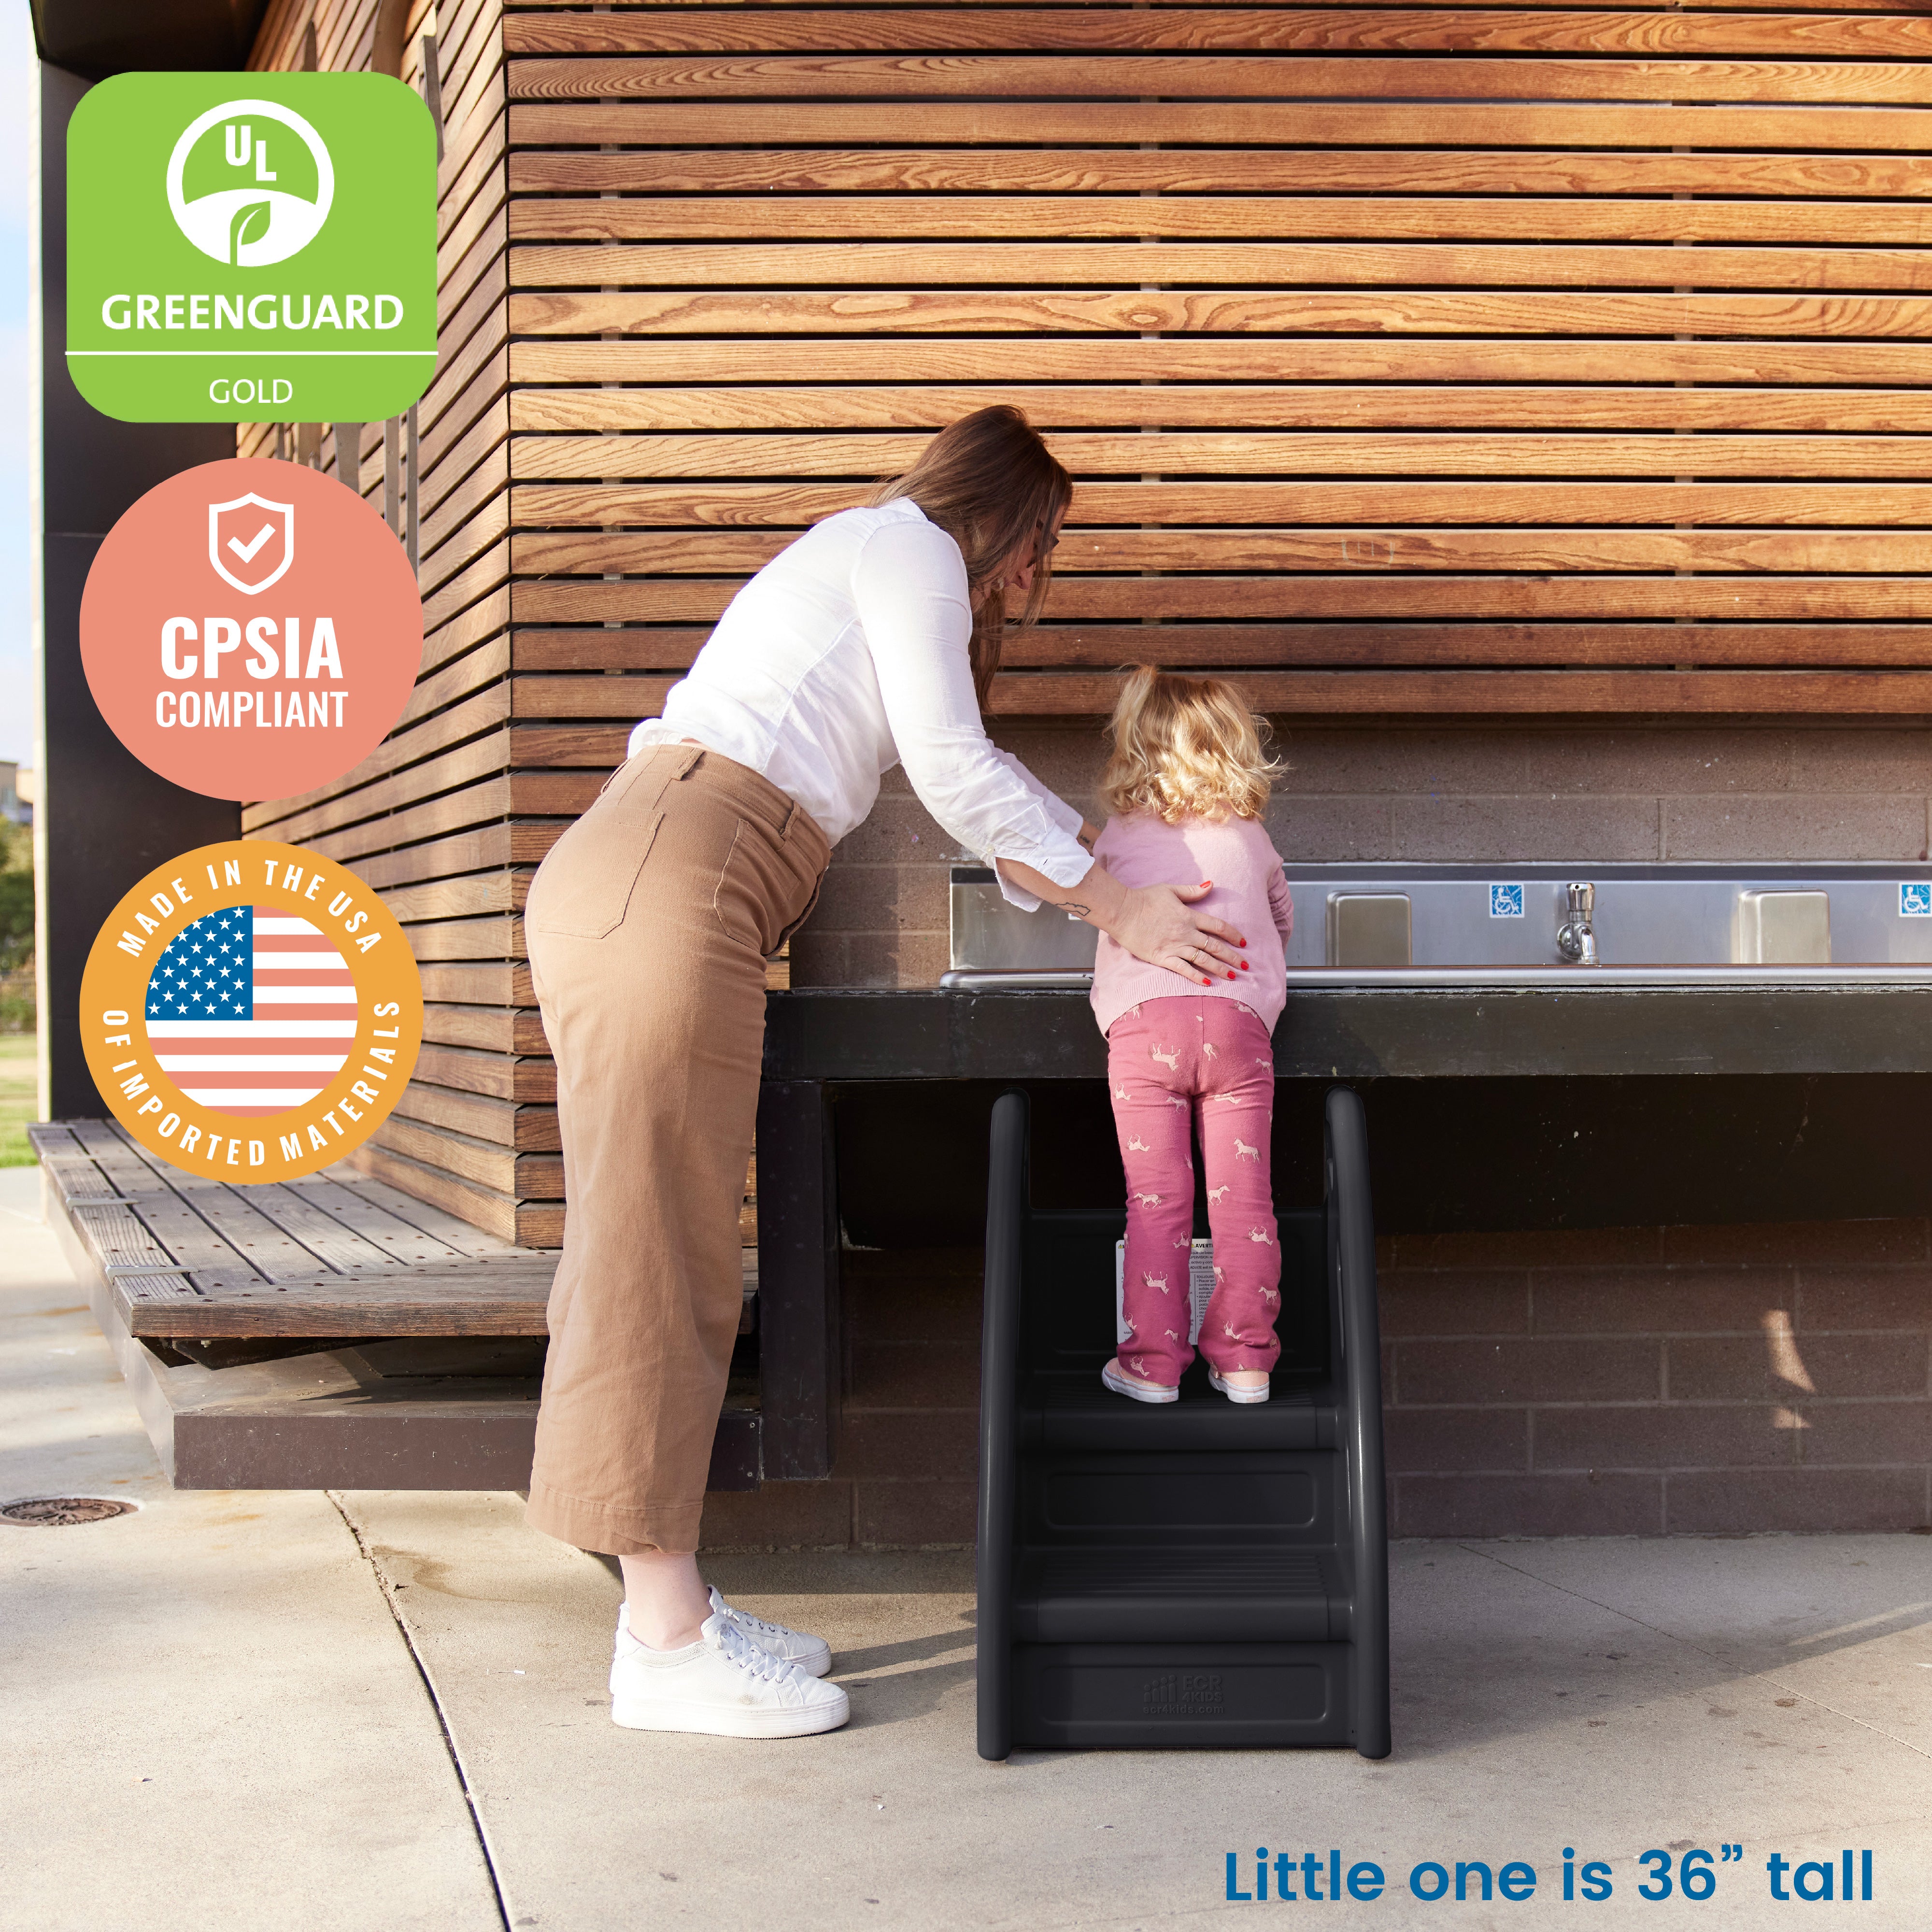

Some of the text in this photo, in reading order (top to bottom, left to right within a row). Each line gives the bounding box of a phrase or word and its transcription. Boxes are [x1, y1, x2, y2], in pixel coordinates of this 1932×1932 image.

[1183, 1675, 1222, 1691] ECR
[1182, 1691, 1223, 1703] 4KIDS
[1143, 1704, 1224, 1715] ecr4kids.com
